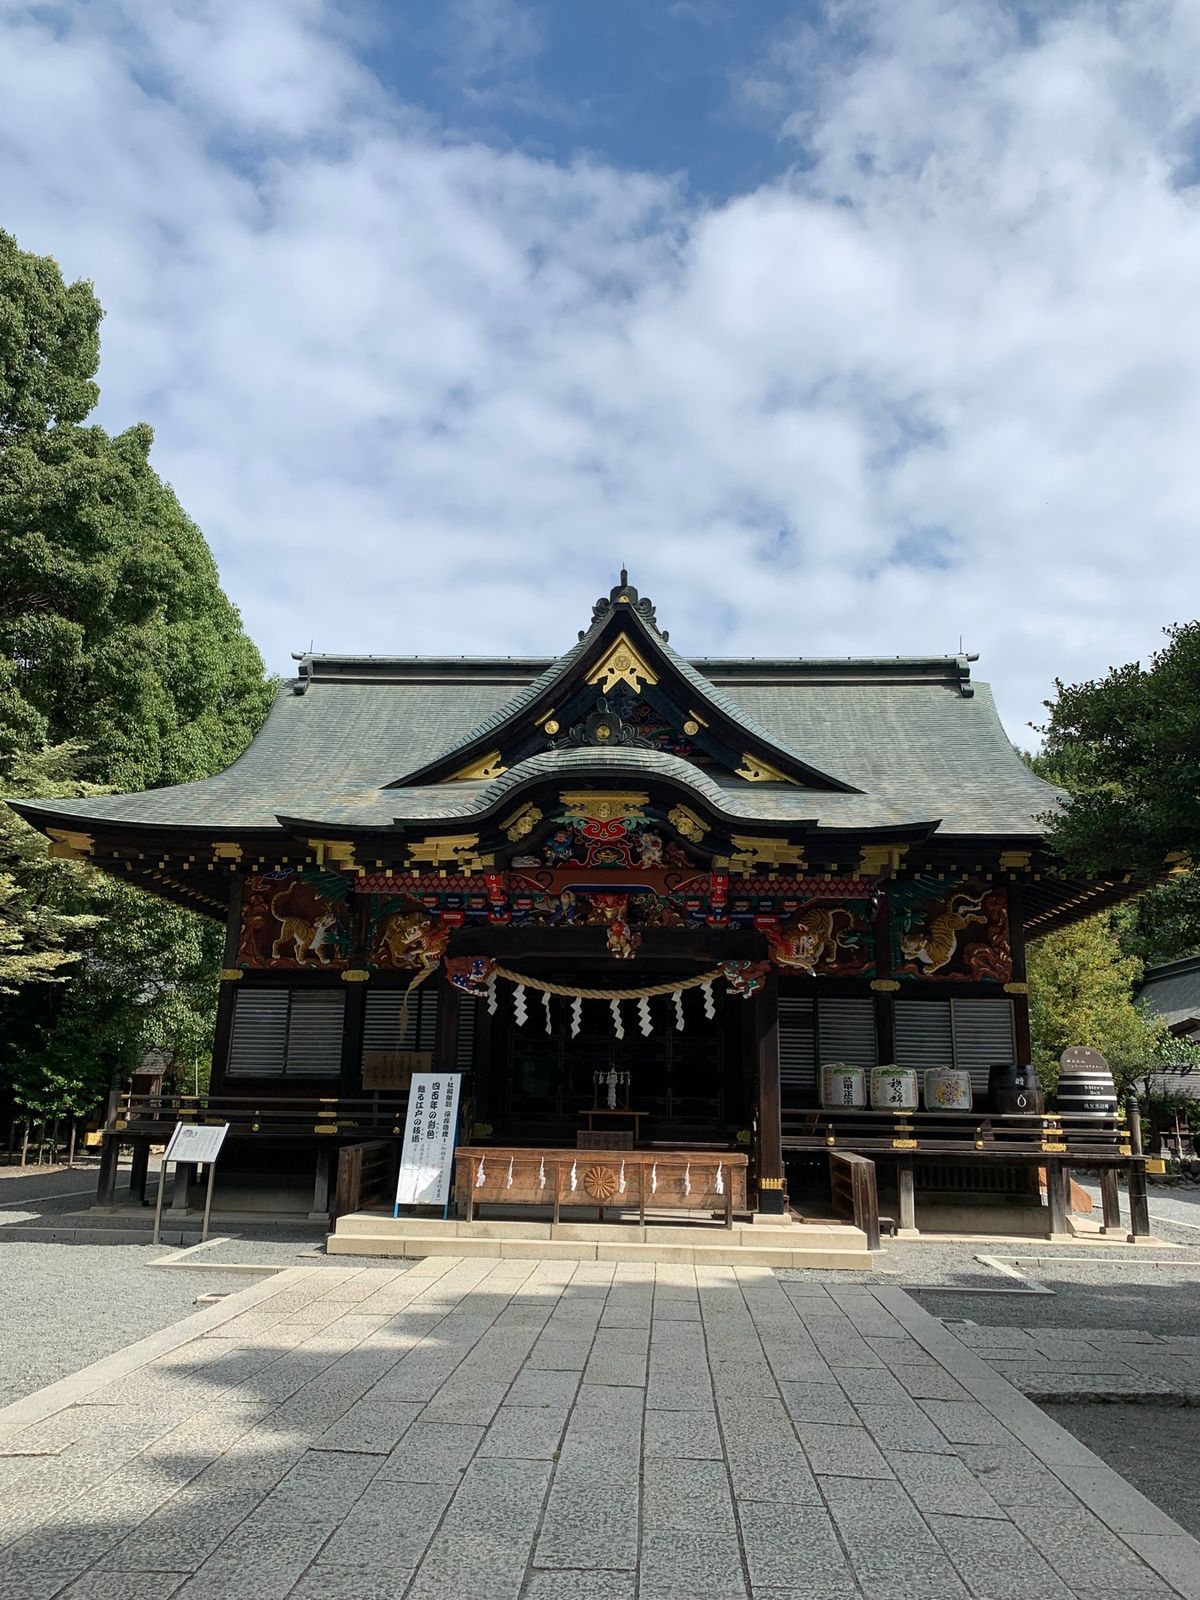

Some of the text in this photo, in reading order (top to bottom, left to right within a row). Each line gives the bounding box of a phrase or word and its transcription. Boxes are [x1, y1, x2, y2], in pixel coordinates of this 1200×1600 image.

[843, 1076, 853, 1104] 武甲正宗
[888, 1078, 903, 1107] 秩父錦
[427, 1082, 440, 1140] 四百年の彩色
